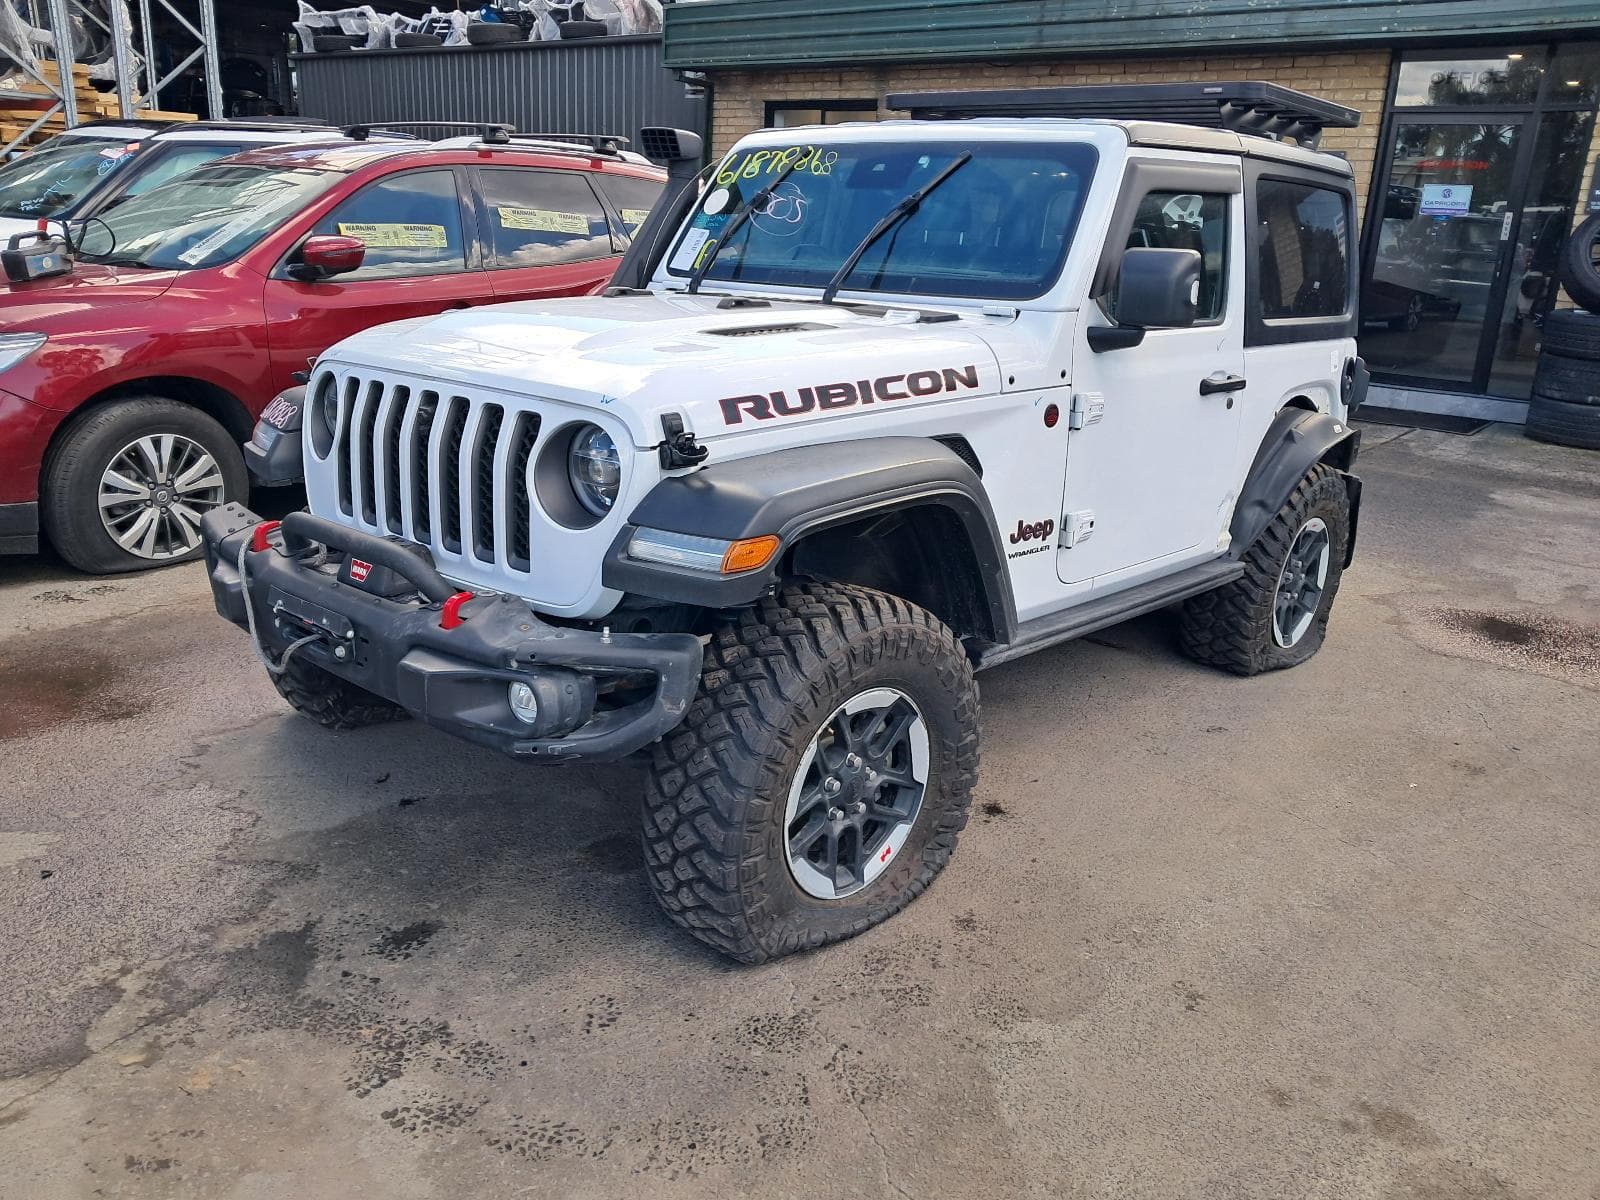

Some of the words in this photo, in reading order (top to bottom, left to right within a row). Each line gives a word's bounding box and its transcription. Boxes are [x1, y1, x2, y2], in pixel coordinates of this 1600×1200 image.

[718, 365, 979, 425] RUBICON
[1010, 518, 1054, 544] Jeep
[1008, 545, 1050, 559] WRANGLER
